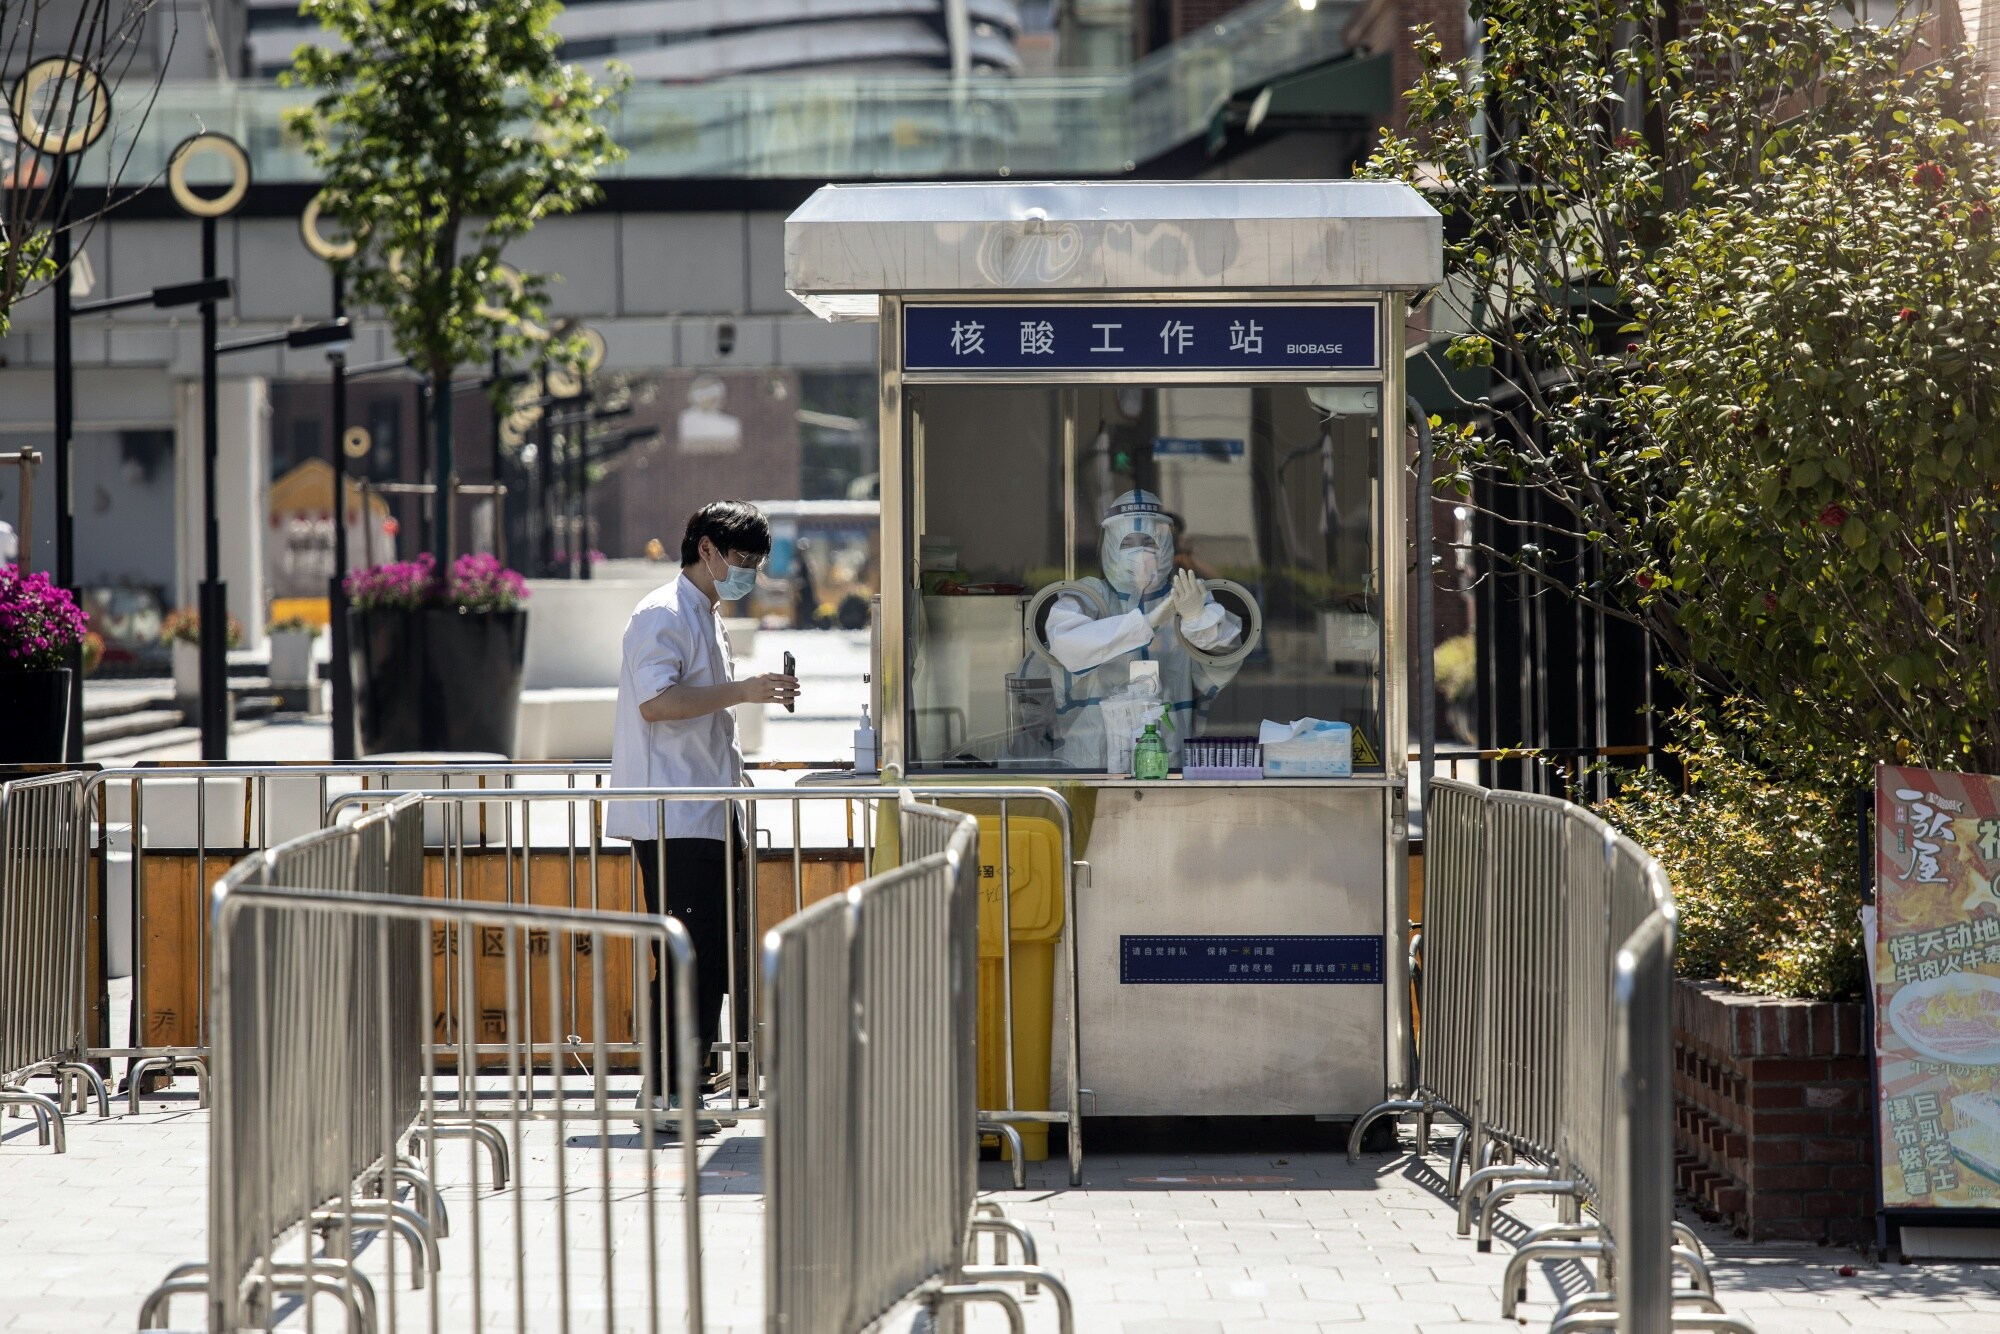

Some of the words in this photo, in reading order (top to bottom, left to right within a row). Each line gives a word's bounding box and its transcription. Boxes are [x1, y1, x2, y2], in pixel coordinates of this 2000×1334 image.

[950, 320, 1264, 355] 核酸工作站
[1286, 344, 1343, 354] BIOBASE
[1132, 946, 1188, 956] 请自觉排队
[1207, 946, 1275, 956] 保持一米间距
[1890, 917, 2000, 963] 惊天动地
[1228, 963, 1273, 973] 应检尽检
[1292, 963, 1372, 973] 打赢抗疫下半场
[1914, 1093, 1955, 1190] 巨乳芝士
